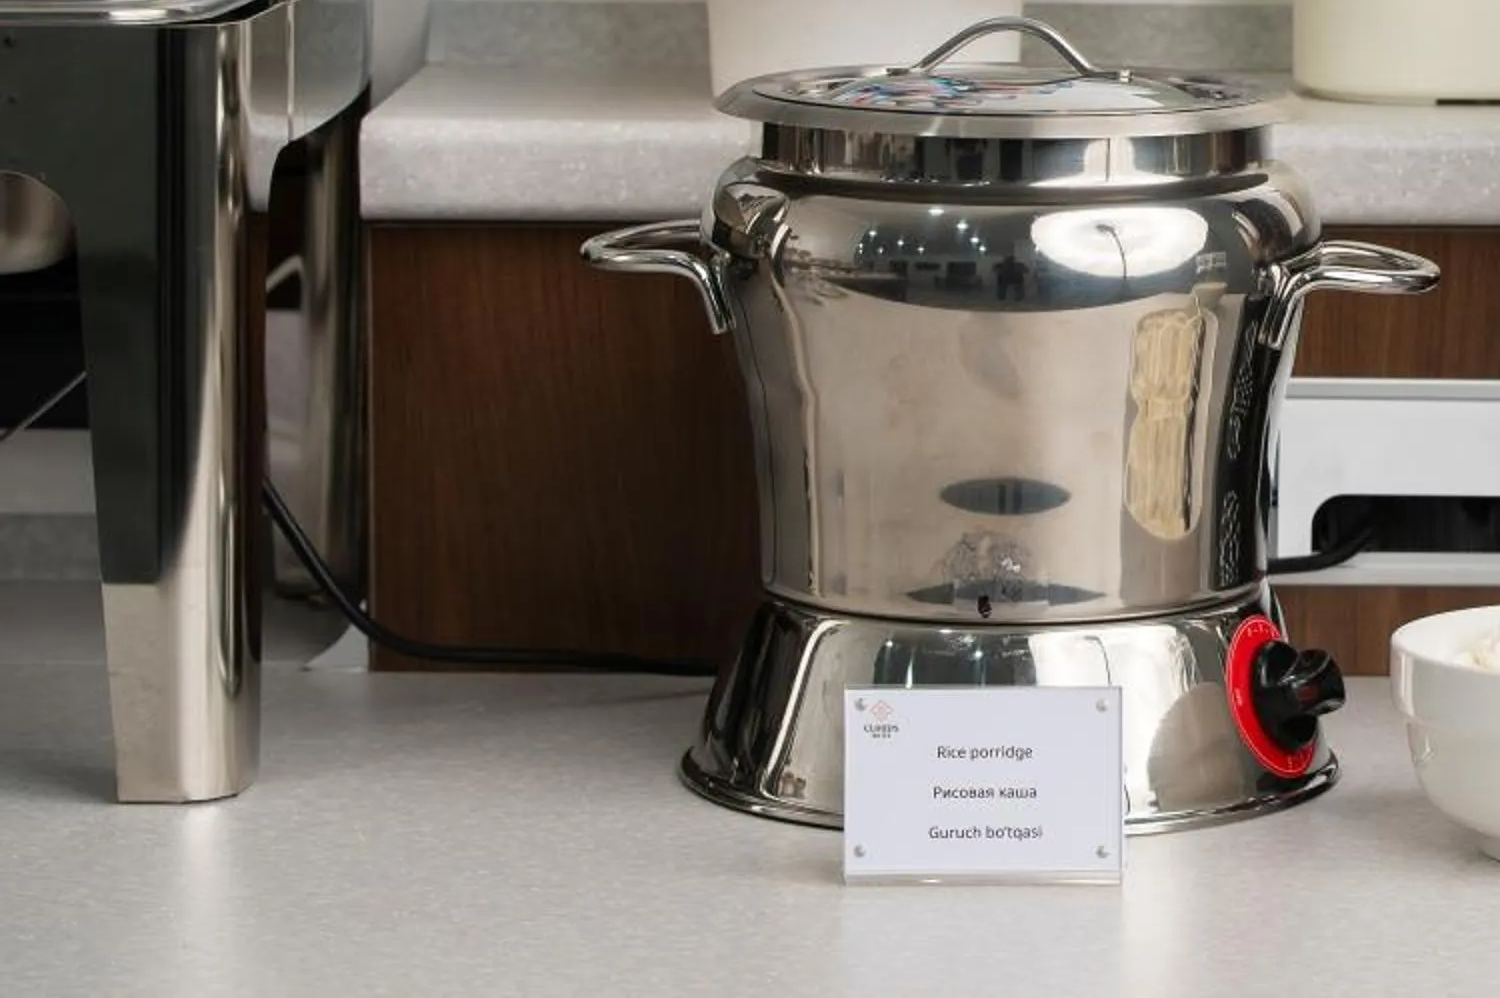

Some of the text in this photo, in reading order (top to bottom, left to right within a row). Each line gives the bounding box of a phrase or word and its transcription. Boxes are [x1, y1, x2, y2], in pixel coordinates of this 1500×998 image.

[936, 745, 1033, 762] Rice porridge
[933, 786, 1037, 799] Рисовая каша
[928, 826, 982, 839] Guruch
